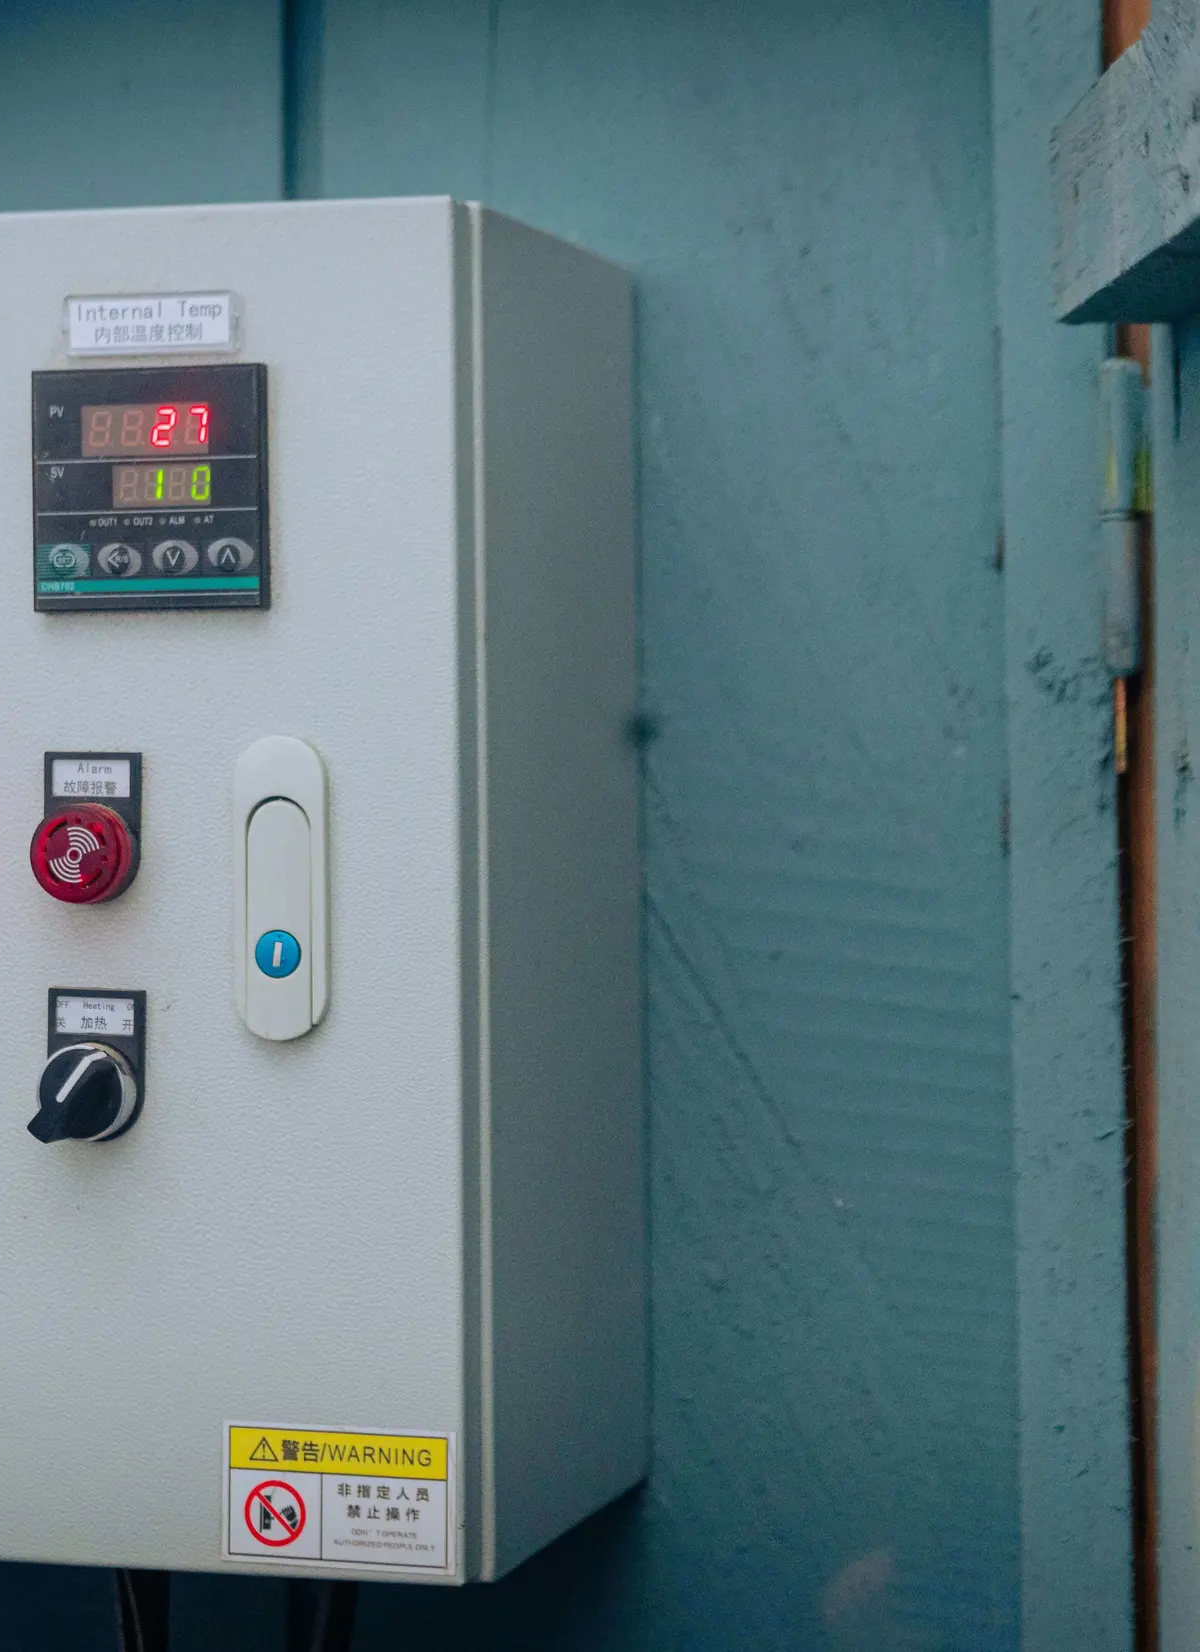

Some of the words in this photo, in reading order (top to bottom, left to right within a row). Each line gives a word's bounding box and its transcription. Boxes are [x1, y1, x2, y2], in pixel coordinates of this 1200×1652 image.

[77, 302, 162, 322] Internal
[178, 300, 222, 319] Temp
[94, 322, 203, 344] 内部温度控制
[50, 406, 64, 418] PV
[151, 404, 209, 447] 27
[50, 467, 65, 479] SV
[98, 516, 118, 527] OUT1
[133, 516, 153, 527] OUT2
[169, 515, 185, 525] ALM
[204, 514, 214, 524] AT
[77, 763, 112, 774] Alarm
[63, 780, 117, 796] 故障报警
[83, 1001, 115, 1011] Heating
[80, 1015, 108, 1030] 加热
[122, 1019, 134, 1031] 开
[281, 1439, 432, 1468] 警告/WARNING
[337, 1482, 430, 1502] 非指定人员
[347, 1504, 420, 1522] 禁止操作
